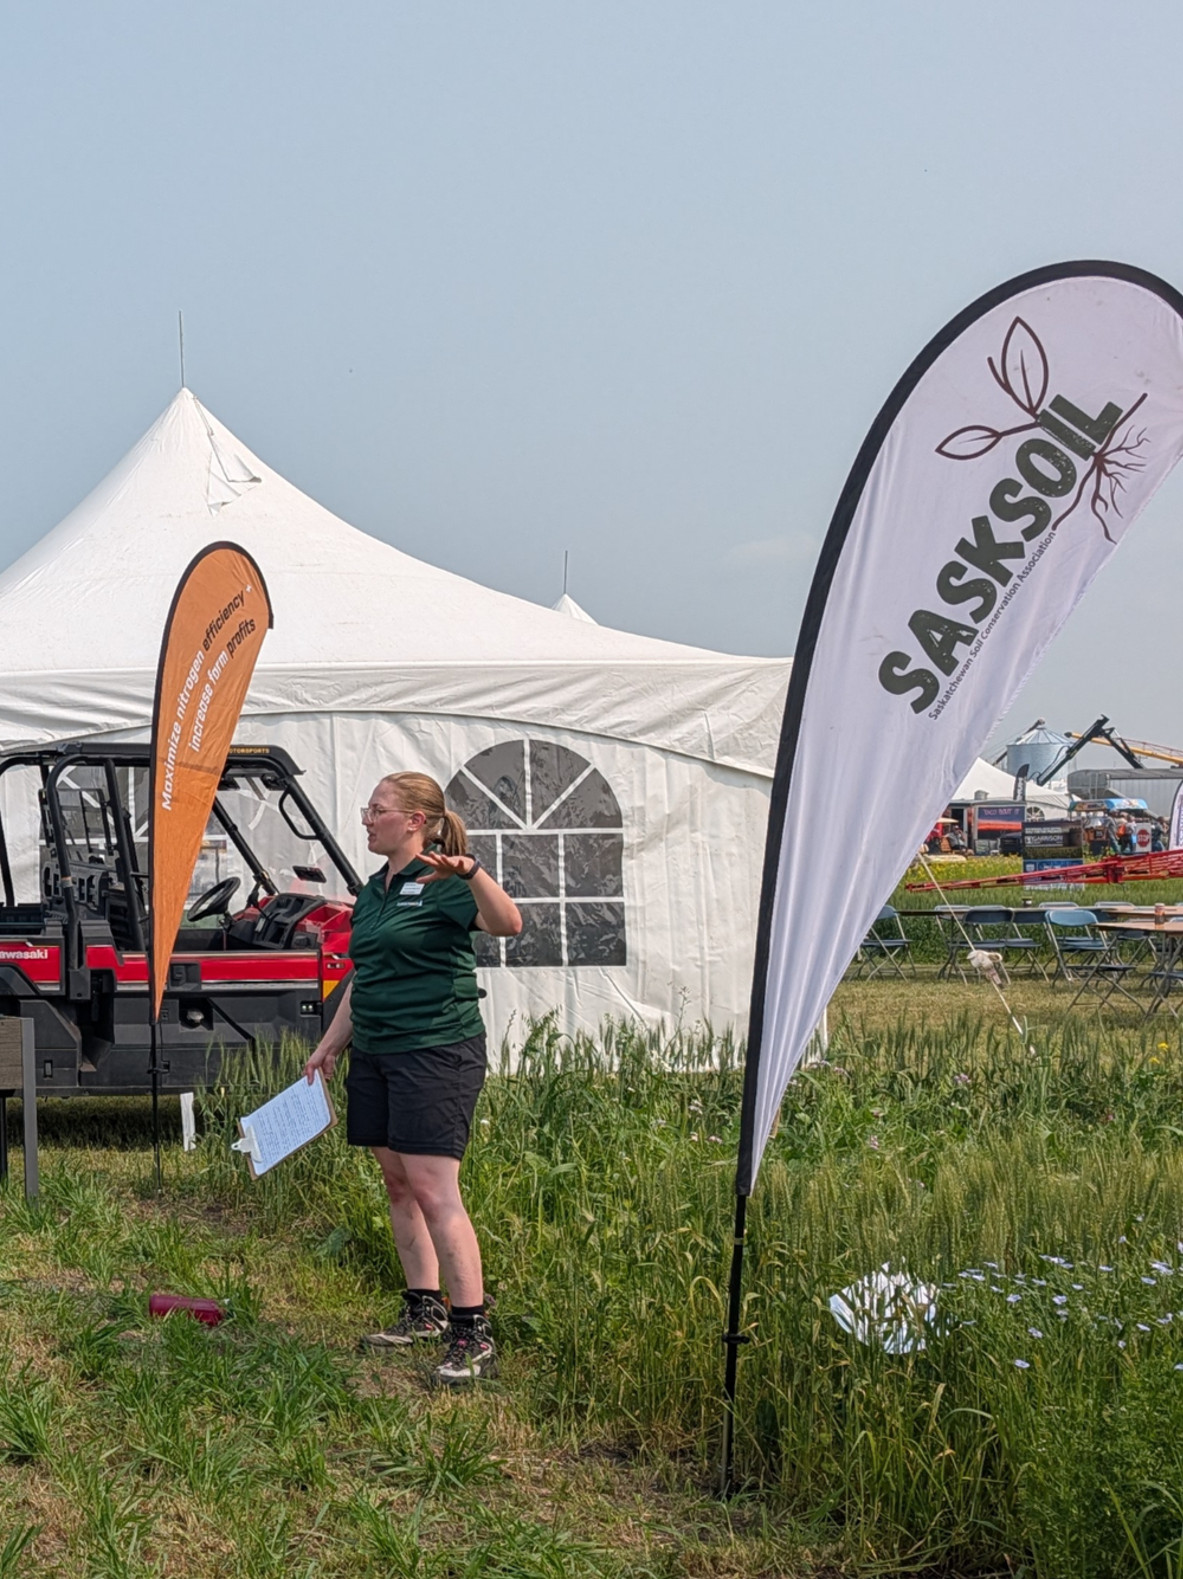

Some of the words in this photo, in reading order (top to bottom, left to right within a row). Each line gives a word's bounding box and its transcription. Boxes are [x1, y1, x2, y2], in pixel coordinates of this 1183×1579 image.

[879, 394, 1123, 714] SASKSOIL
[929, 657, 974, 720] Saskatchewan
[971, 640, 984, 658] Soil
[981, 582, 1021, 641] Conservation
[1016, 531, 1056, 583] Association
[161, 721, 182, 811] Maximize
[176, 650, 205, 720] nitrogen
[202, 590, 245, 651] efficiency
[189, 683, 214, 752] increase
[207, 650, 229, 685] farm
[226, 619, 256, 660] profits
